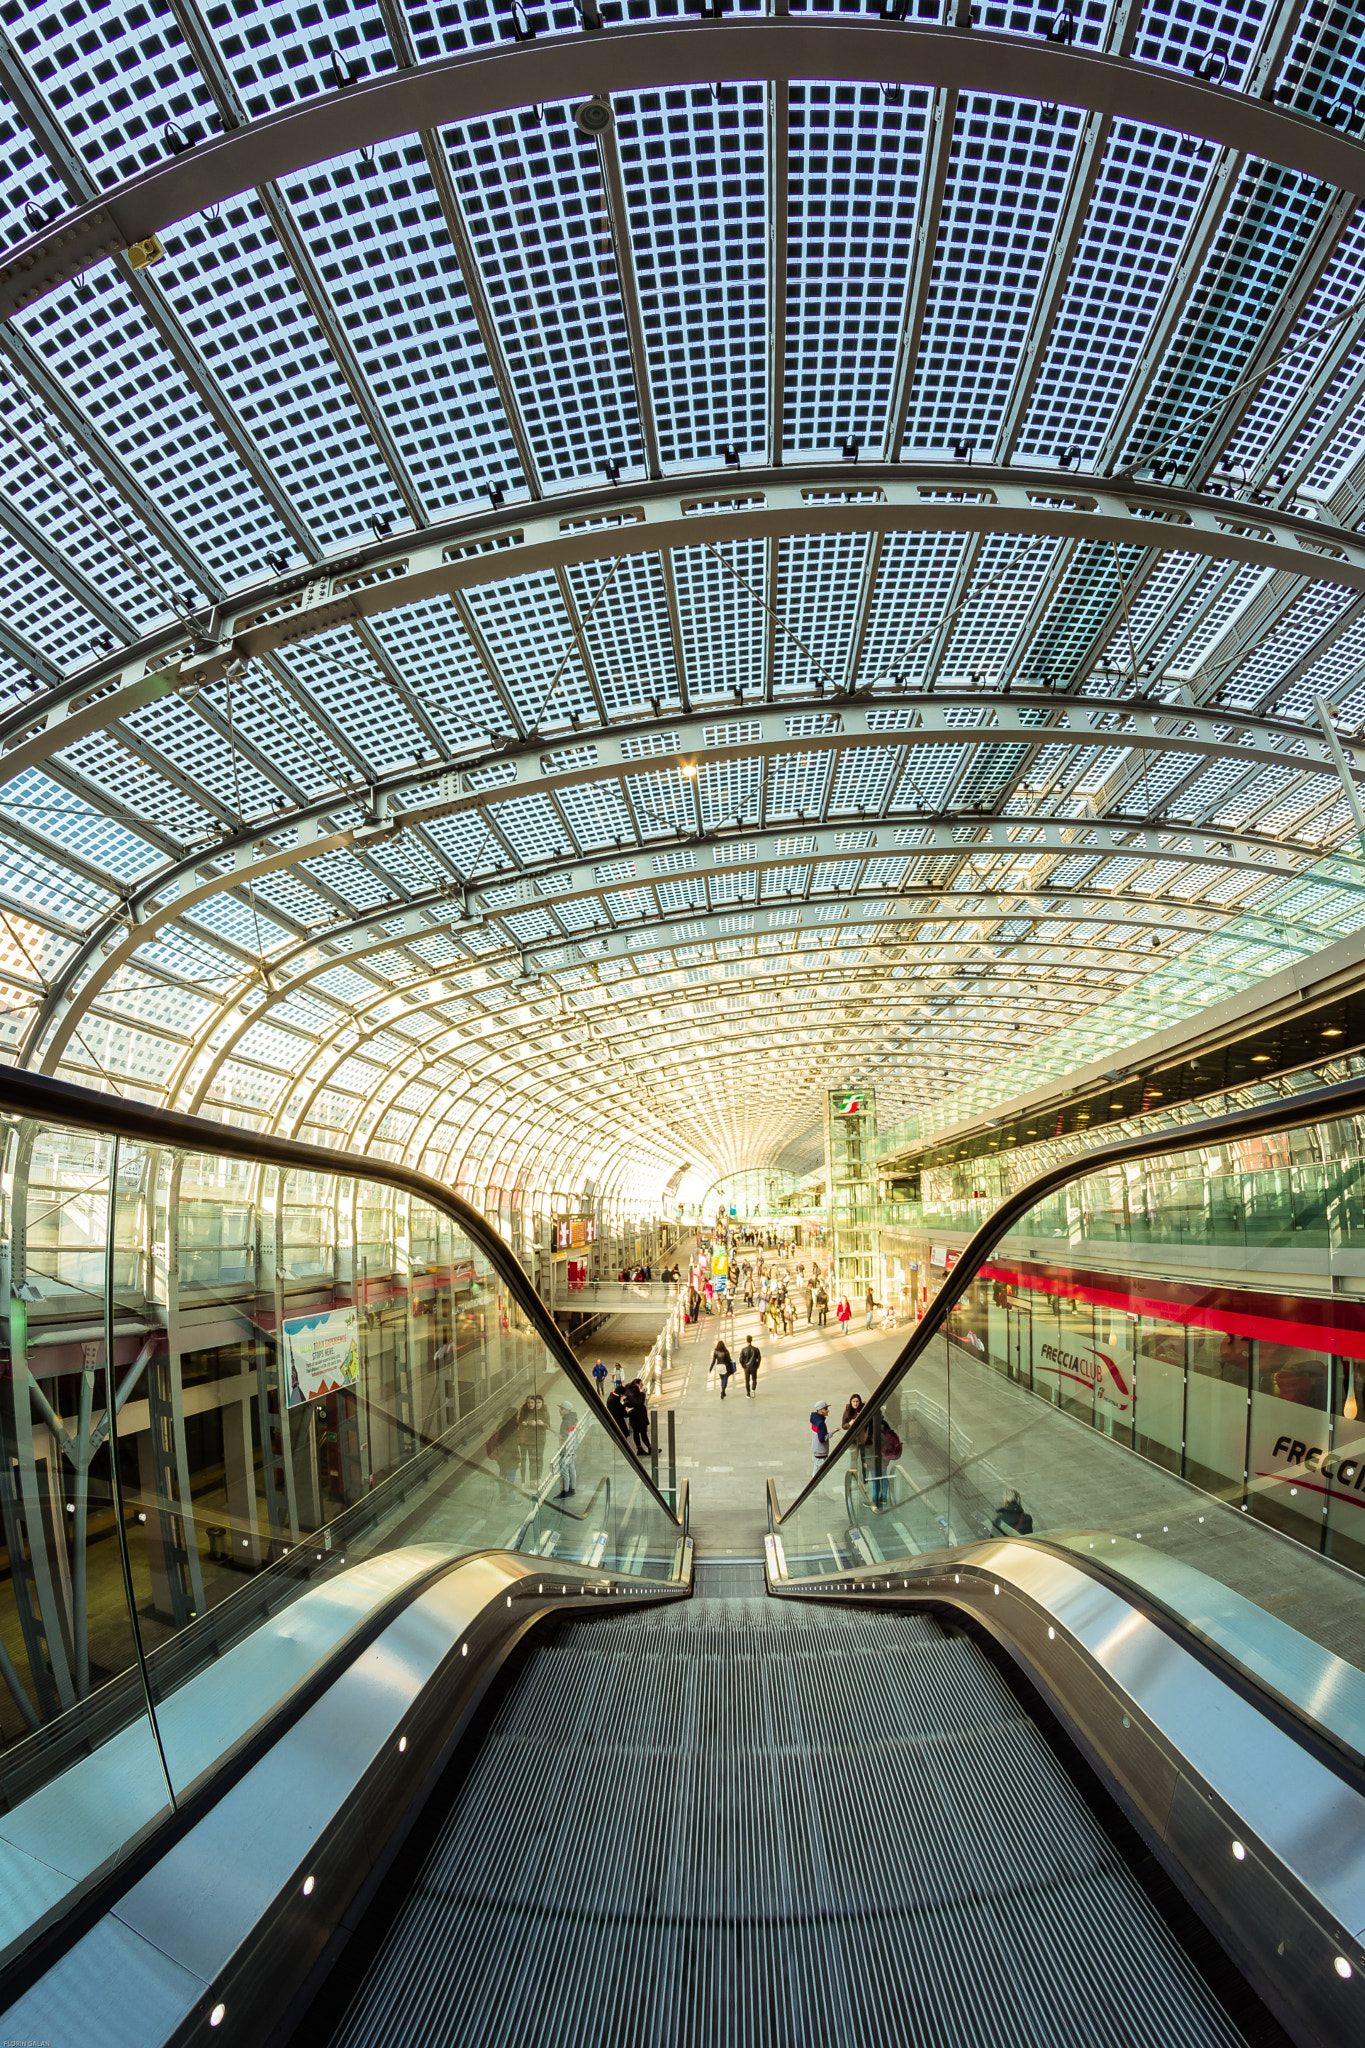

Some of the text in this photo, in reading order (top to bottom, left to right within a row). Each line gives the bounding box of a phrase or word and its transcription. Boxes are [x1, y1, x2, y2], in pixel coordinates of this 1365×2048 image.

[312, 1347, 334, 1360] STOPS HERE
[1272, 1436, 1365, 1493] FRECCI
